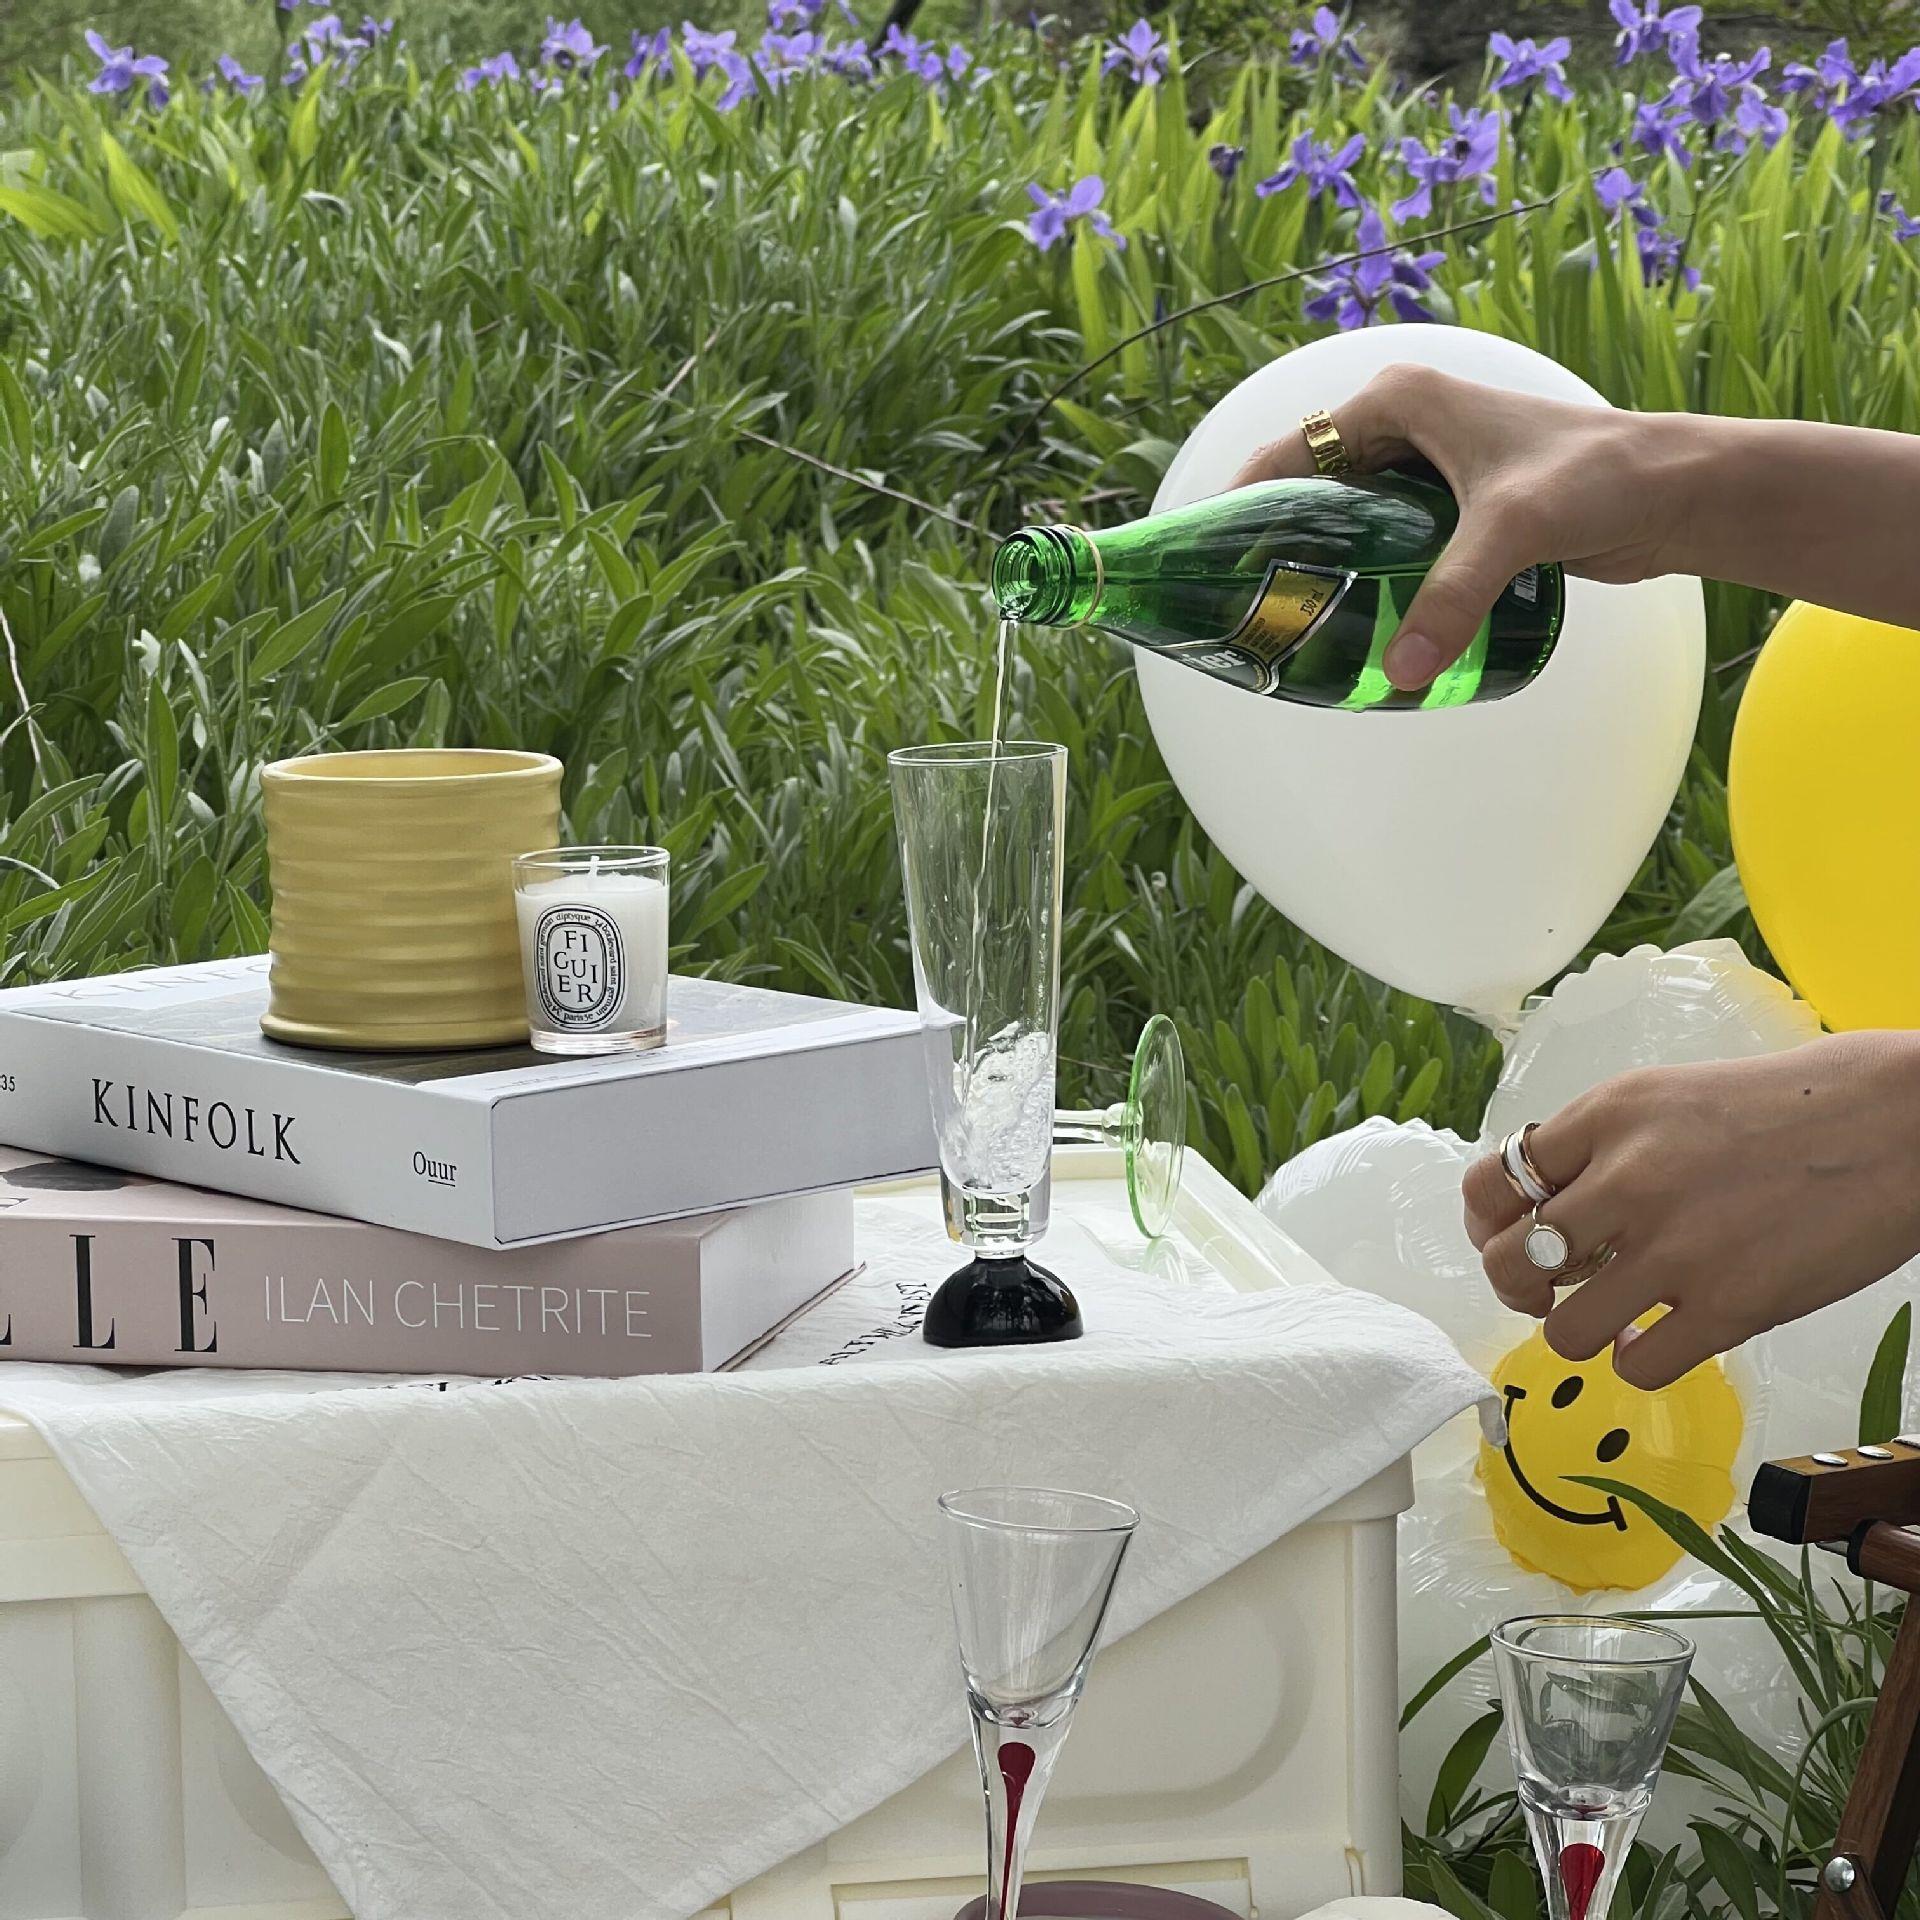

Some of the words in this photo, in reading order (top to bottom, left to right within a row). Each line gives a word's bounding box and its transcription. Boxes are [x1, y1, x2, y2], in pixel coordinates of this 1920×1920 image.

[556, 913, 591, 922] diptyque
[564, 930, 588, 952] FI
[601, 924, 617, 963] boulevard
[564, 1012, 583, 1021] paris
[596, 986, 615, 1016] germain
[0, 1074, 15, 1092] 35
[91, 1078, 301, 1165] KINFOLK
[413, 1151, 457, 1183] Ouur
[0, 1234, 218, 1353] LE
[264, 1274, 374, 1326] ILAN
[394, 1279, 653, 1338] CHETRITE
